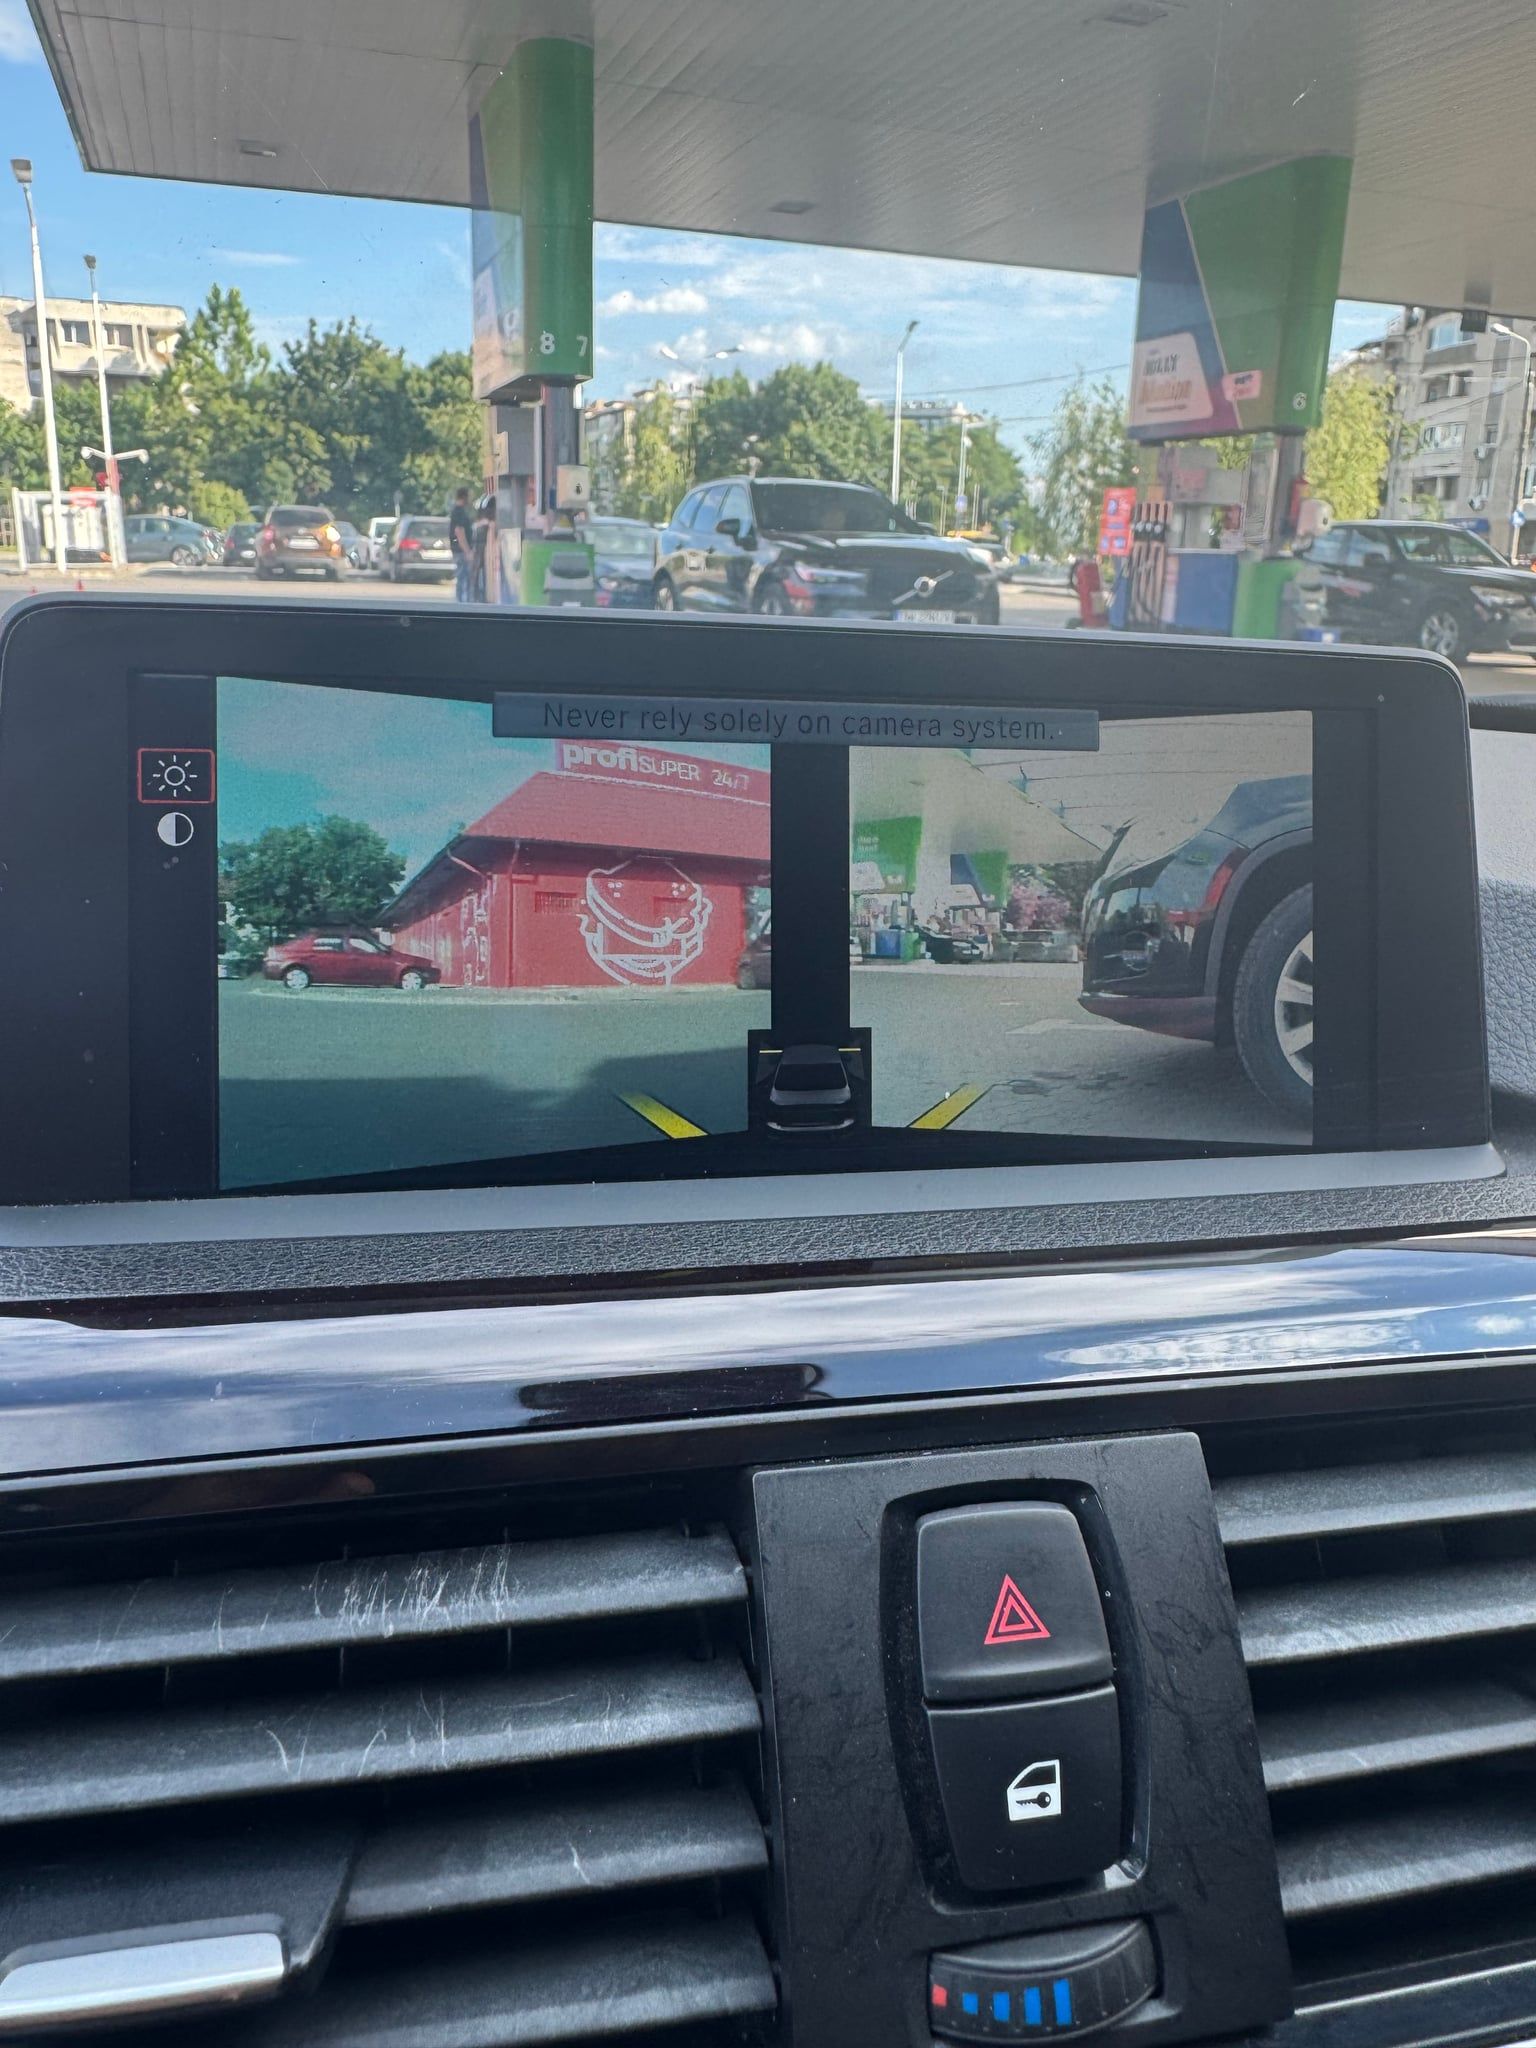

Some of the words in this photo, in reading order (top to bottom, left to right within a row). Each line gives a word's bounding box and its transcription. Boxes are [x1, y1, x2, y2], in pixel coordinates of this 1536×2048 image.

[540, 332, 556, 354] 8
[576, 335, 588, 357] 7
[544, 703, 630, 729] Never
[640, 707, 692, 736] rely
[703, 708, 788, 738] solely
[798, 714, 830, 735] on
[842, 715, 942, 737] camera
[952, 717, 1055, 743] system.
